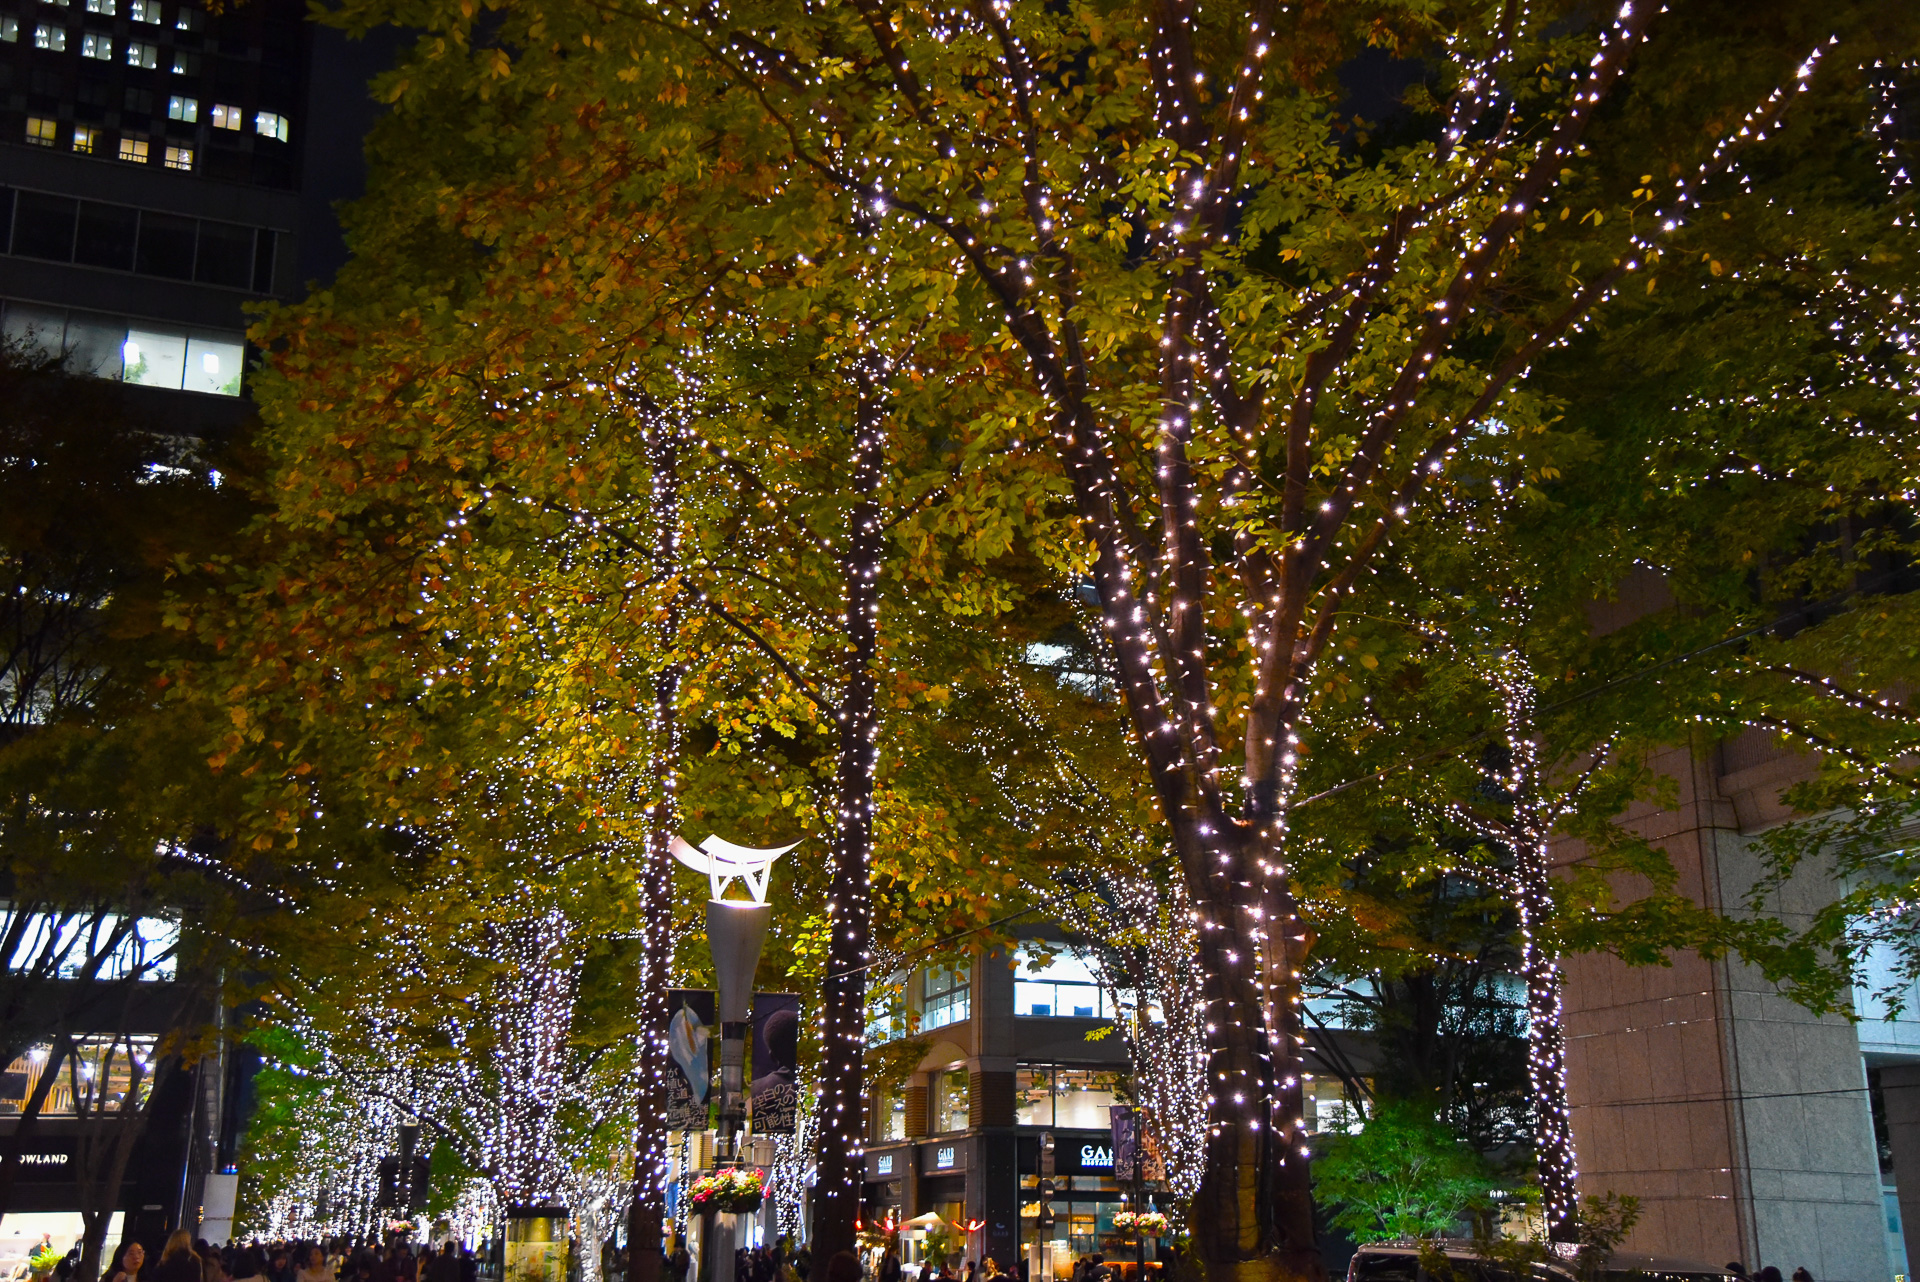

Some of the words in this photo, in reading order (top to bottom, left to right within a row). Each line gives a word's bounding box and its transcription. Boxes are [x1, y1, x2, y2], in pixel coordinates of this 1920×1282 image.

[753, 1083, 795, 1109] 空白のス
[753, 1111, 795, 1130] 可能性
